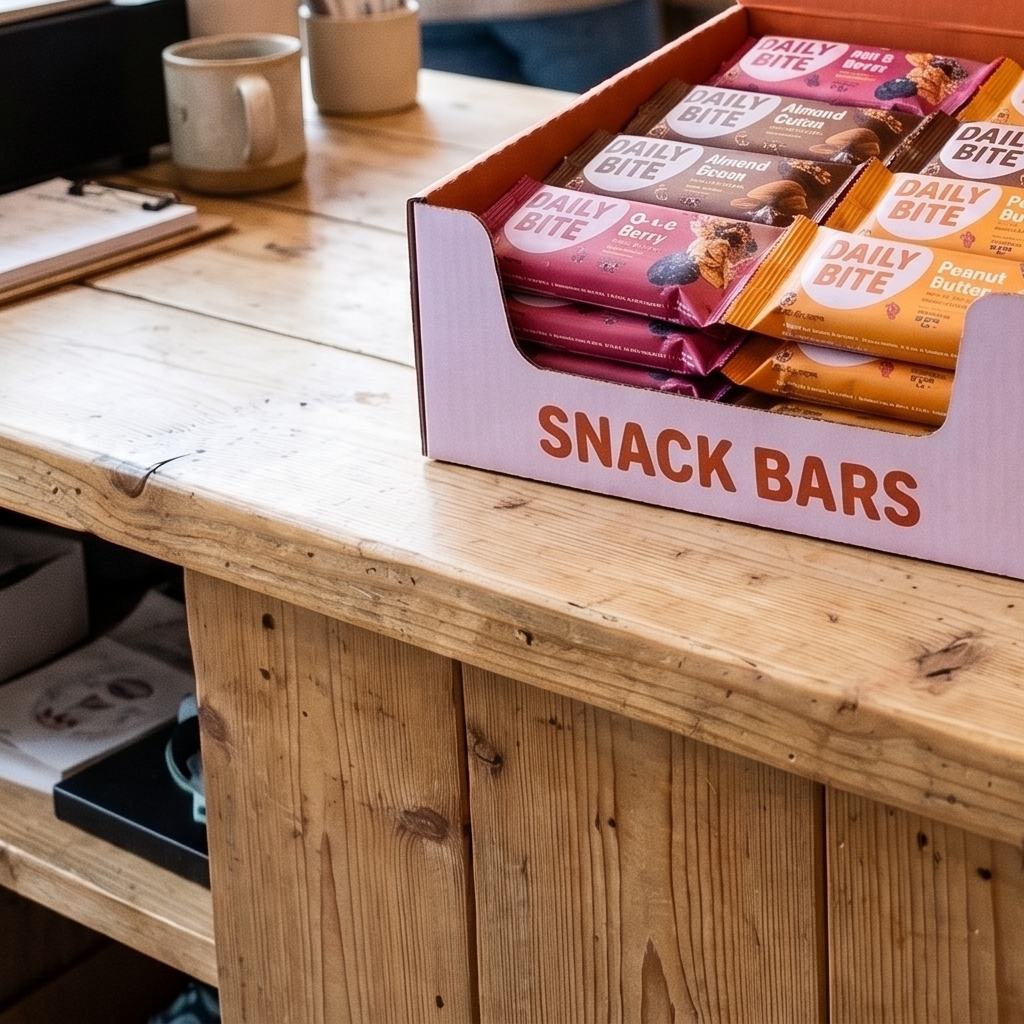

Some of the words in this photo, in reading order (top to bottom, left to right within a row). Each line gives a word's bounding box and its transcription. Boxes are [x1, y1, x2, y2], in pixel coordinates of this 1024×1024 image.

[757, 38, 838, 57] DAILY
[751, 52, 814, 71] BITE
[684, 89, 772, 111] DAILY
[677, 106, 745, 127] BITE
[604, 139, 694, 162] DAILY
[952, 144, 1024, 167] BITE
[594, 156, 666, 180] BITE
[894, 179, 991, 204] DAILY
[525, 191, 617, 220] DAILY
[887, 200, 965, 226] BITE
[514, 212, 589, 242] BITE
[617, 224, 668, 246] Berry
[820, 239, 921, 270] DAILY
[812, 263, 894, 295] BITE
[937, 260, 1007, 285] Peanut
[929, 275, 992, 297] Butter
[537, 404, 737, 493] SNACK
[753, 445, 921, 528] BARS
